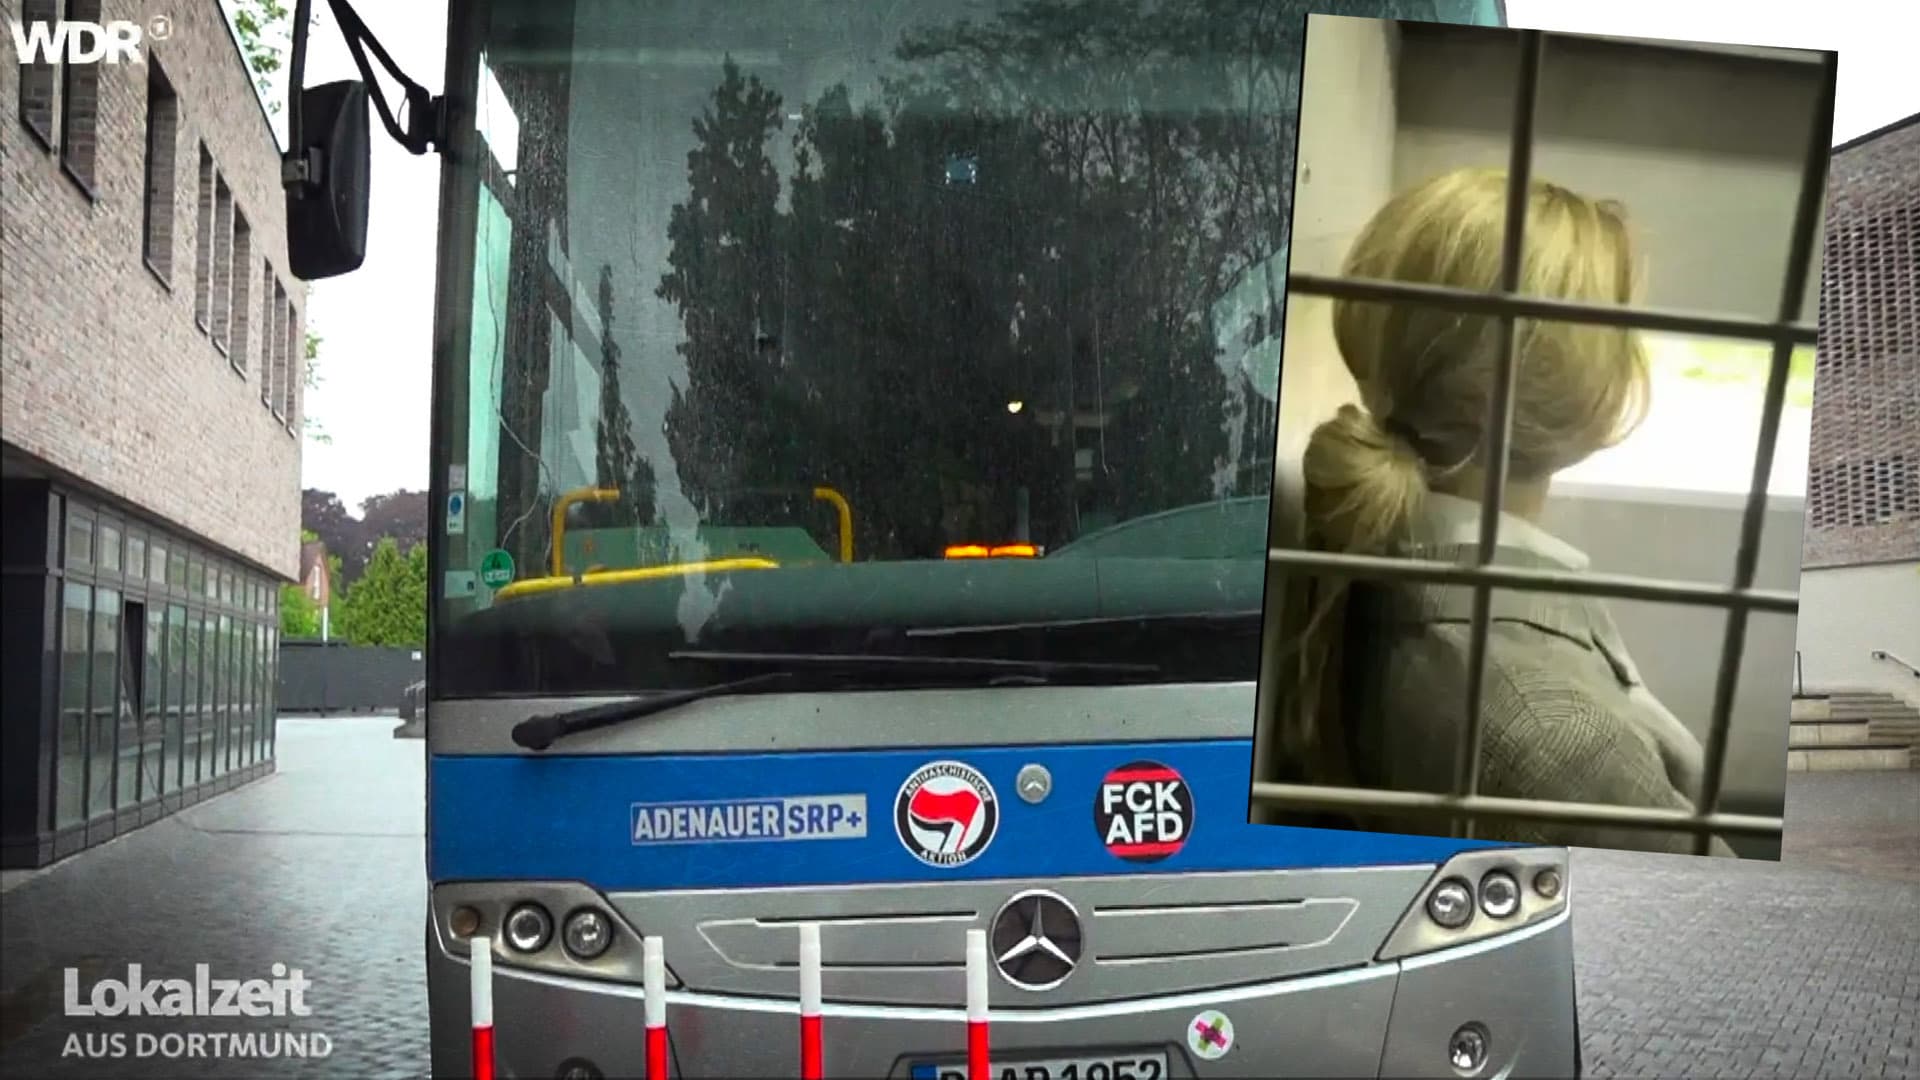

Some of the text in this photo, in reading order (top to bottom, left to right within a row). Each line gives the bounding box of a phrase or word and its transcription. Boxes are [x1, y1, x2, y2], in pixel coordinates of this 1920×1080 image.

[904, 764, 993, 802] ANTIFASCHISTISCHE
[1103, 781, 1182, 814] FCK
[1105, 811, 1184, 845] AFD
[921, 849, 967, 866] AKTION
